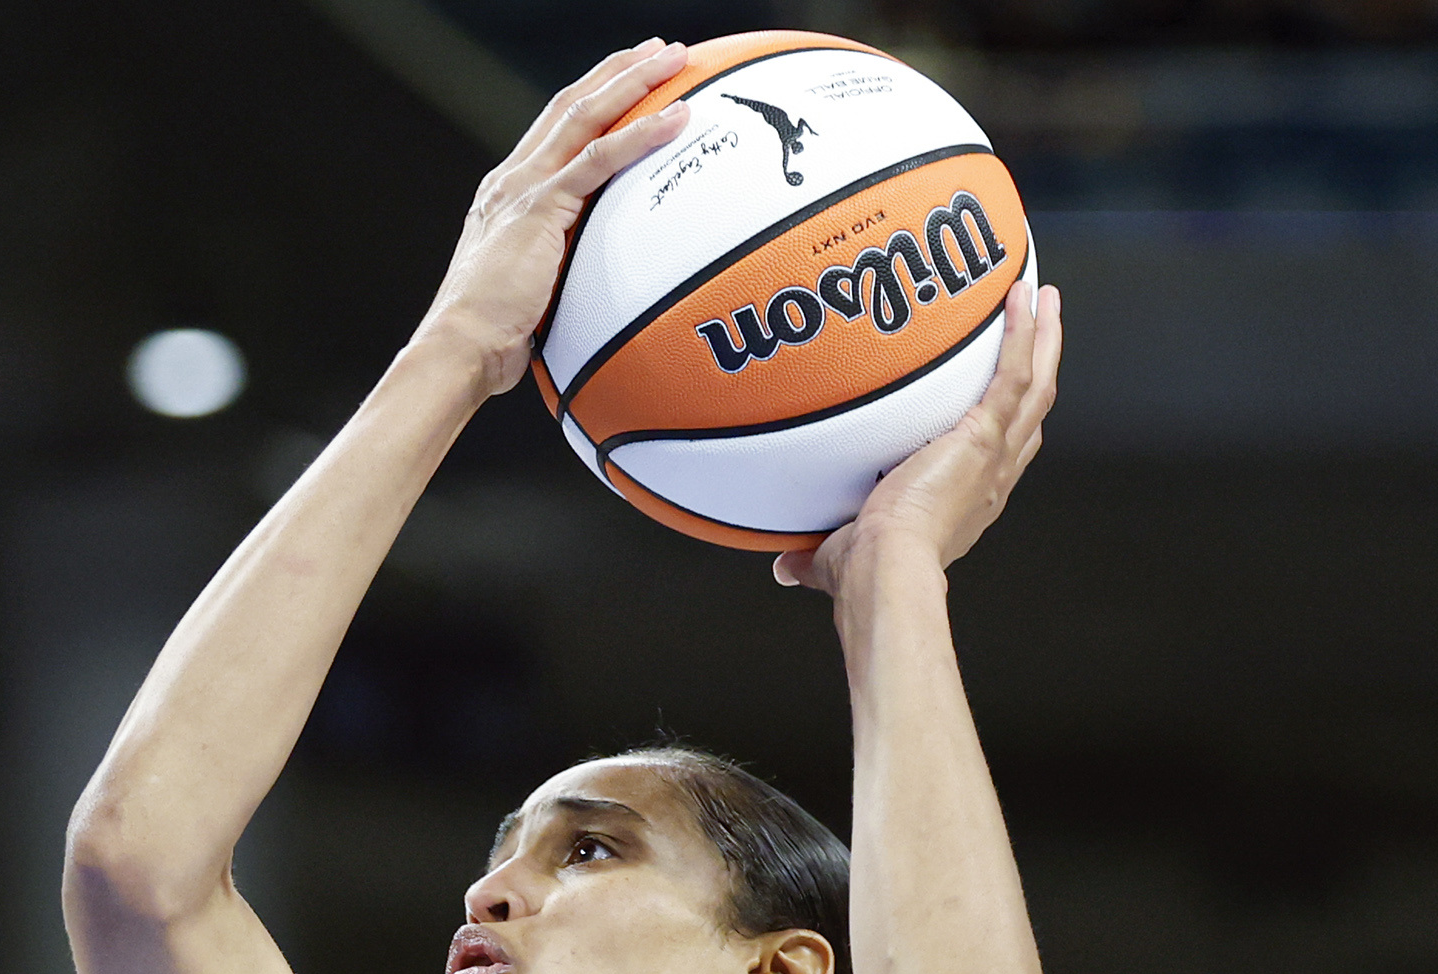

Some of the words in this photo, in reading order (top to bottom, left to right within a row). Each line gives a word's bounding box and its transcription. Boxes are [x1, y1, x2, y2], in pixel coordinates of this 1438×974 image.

[822, 85, 893, 101] OFFICIAL
[851, 210, 887, 235] EVO
[811, 230, 847, 256] NXT
[696, 190, 1008, 374] Wilson
